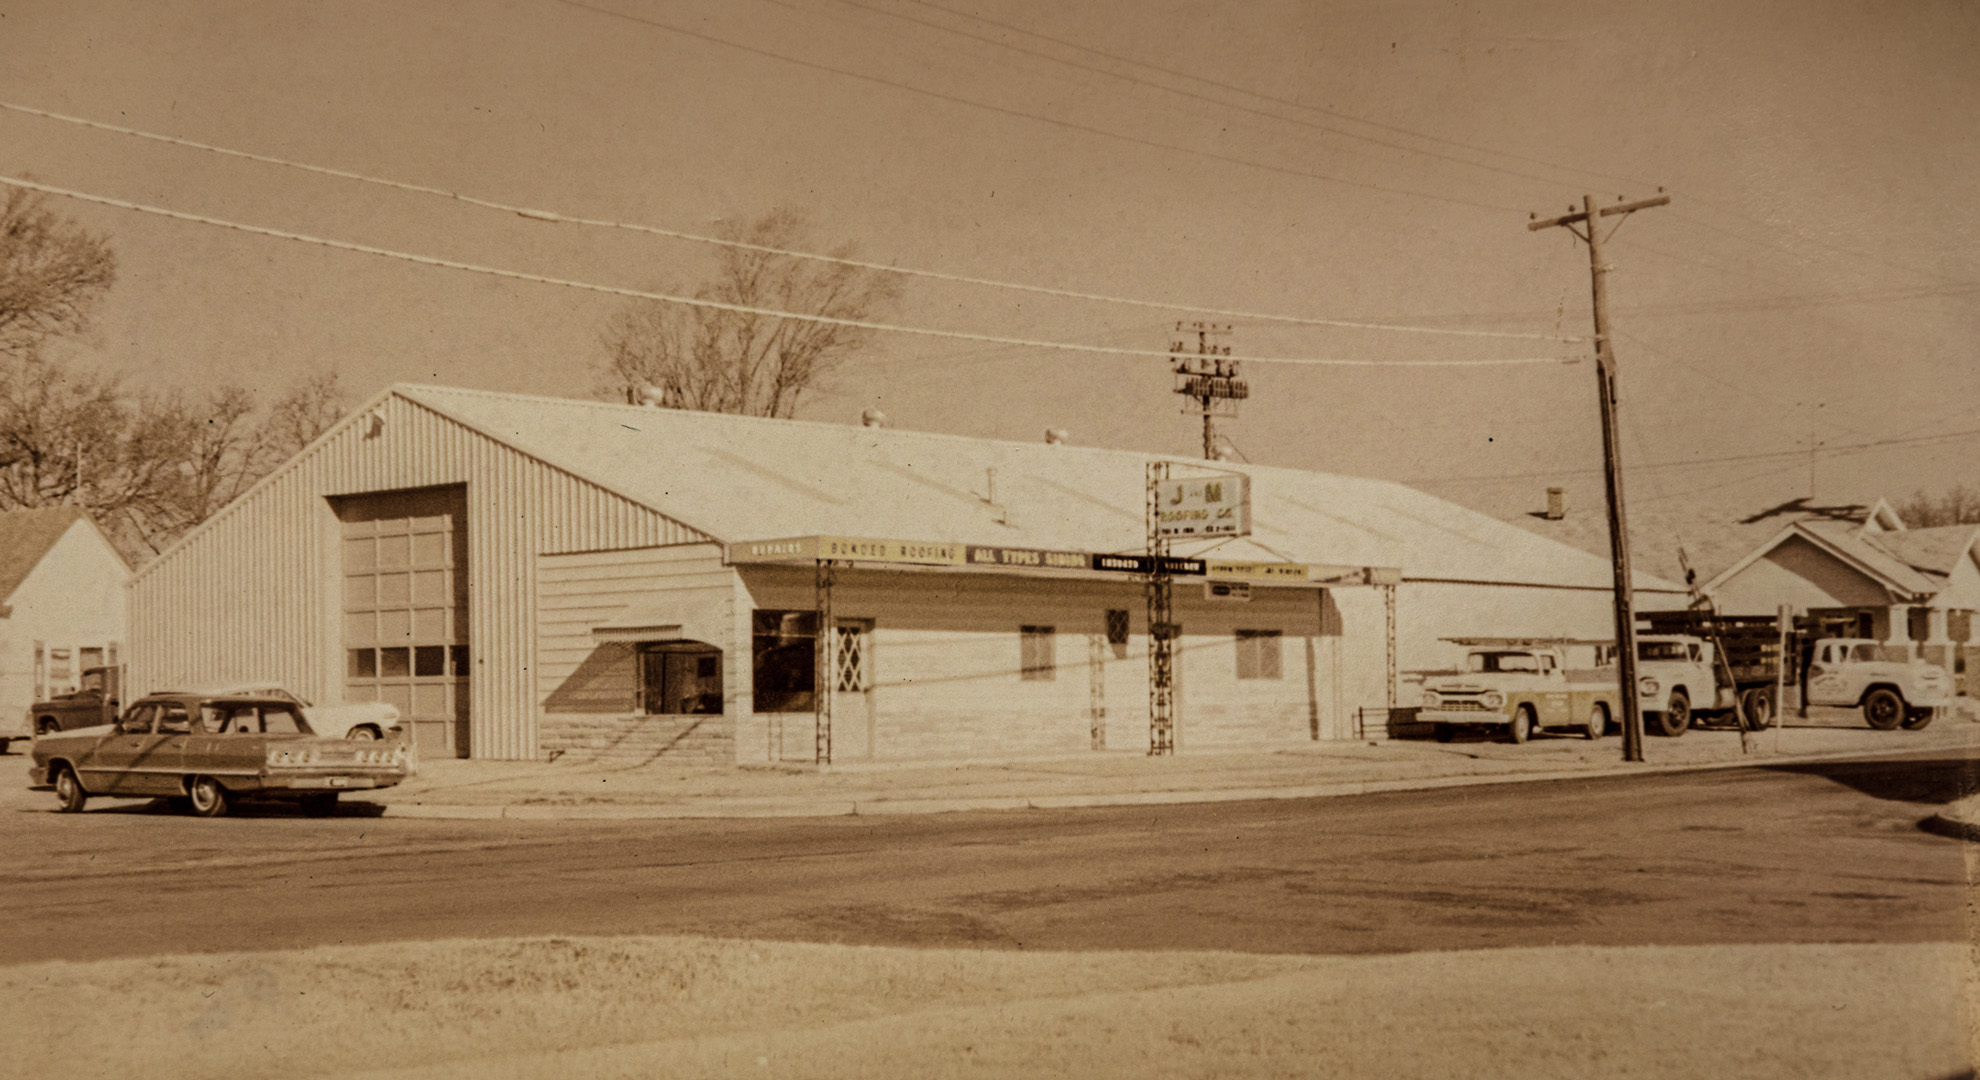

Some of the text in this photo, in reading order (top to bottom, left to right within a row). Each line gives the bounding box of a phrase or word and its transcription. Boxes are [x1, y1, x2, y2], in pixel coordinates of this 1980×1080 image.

[1170, 481, 1222, 505] J M
[831, 542, 955, 559] BONDED ROOFING
[974, 548, 996, 562] ALL
[1002, 550, 1039, 564] TYPES
